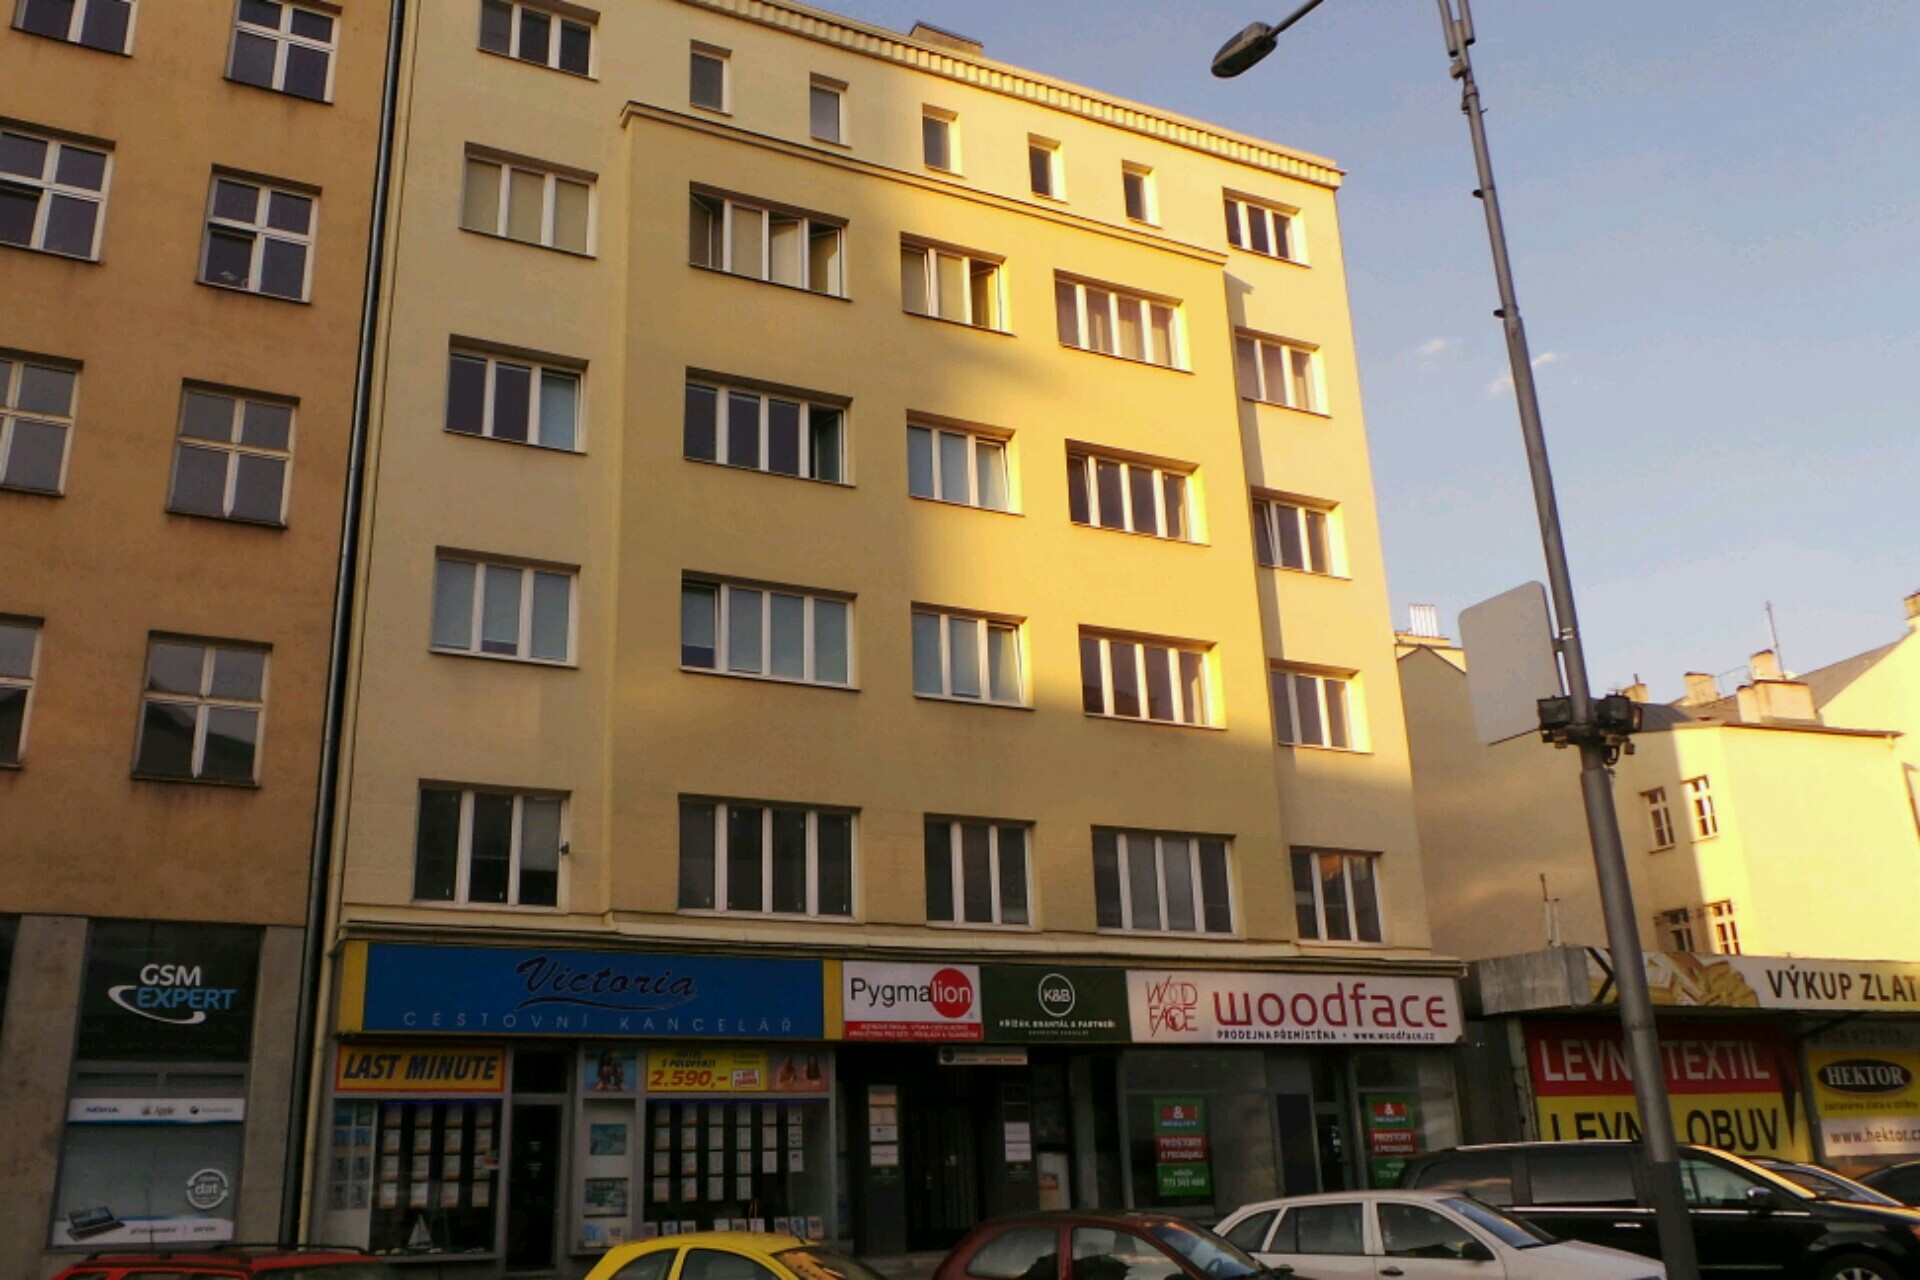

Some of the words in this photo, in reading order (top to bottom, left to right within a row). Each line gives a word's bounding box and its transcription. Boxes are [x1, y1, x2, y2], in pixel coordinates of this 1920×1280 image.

[140, 963, 202, 987] GSM
[515, 955, 695, 997] Victoria
[1766, 964, 1852, 1000] VÝKUP
[136, 986, 238, 1010] EXPERT
[850, 976, 971, 1008] Pygmalion
[1043, 989, 1072, 1002] K&B
[1212, 981, 1448, 1028] woodface
[403, 1012, 589, 1028] CESTOVNÍ
[619, 1016, 793, 1032] KANCELÁŘ
[1217, 1030, 1271, 1040] PRODEJNA
[343, 1053, 402, 1080] LAST
[404, 1054, 498, 1081] MINUTE
[1540, 1038, 1633, 1082] LEVN
[1660, 1039, 1771, 1081] TEXTIL
[651, 1070, 728, 1089] 2.590,-
[1825, 1066, 1905, 1086] HEKTOR
[1551, 1111, 1645, 1142] LEVN
[1686, 1108, 1778, 1151] OBUV
